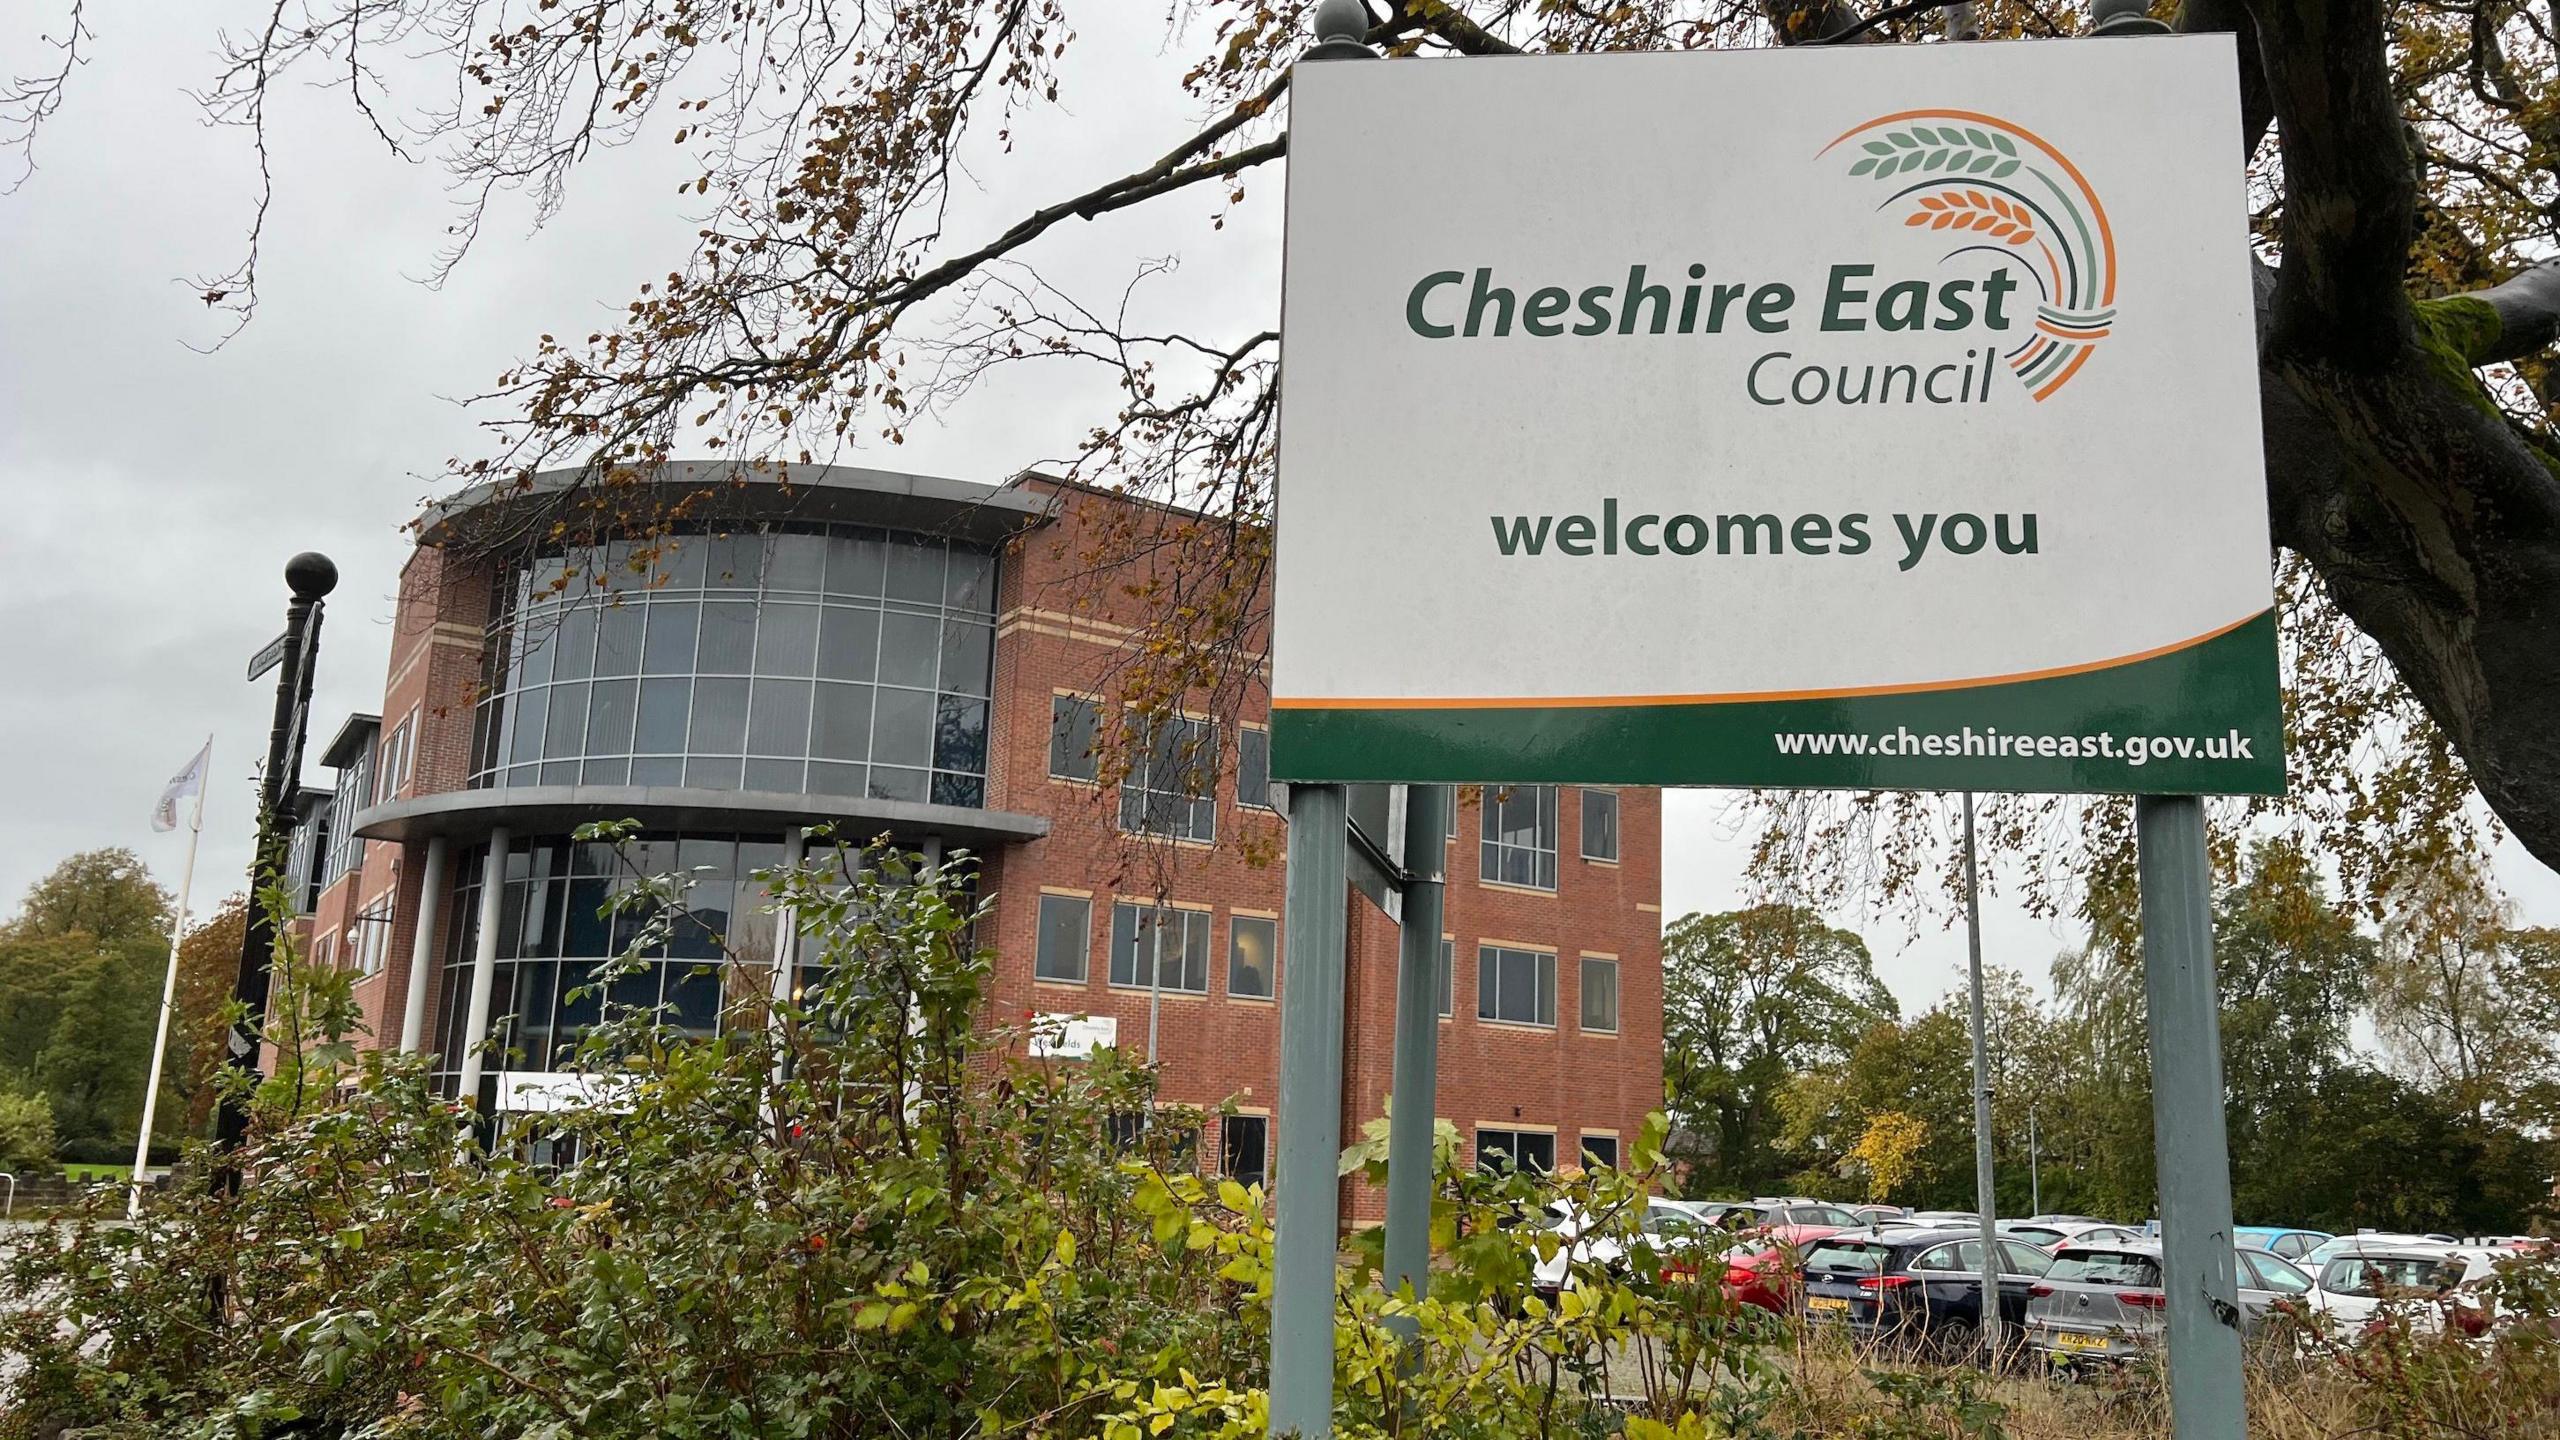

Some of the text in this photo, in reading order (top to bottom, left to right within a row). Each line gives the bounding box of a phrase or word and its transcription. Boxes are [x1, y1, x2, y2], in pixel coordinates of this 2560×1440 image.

[1406, 263, 2018, 339] Cheshire East
[1747, 347, 1996, 406] Council
[1491, 498, 2039, 571] welcomes you
[1775, 726, 2254, 766] www.cheshireeast.gov.uk
